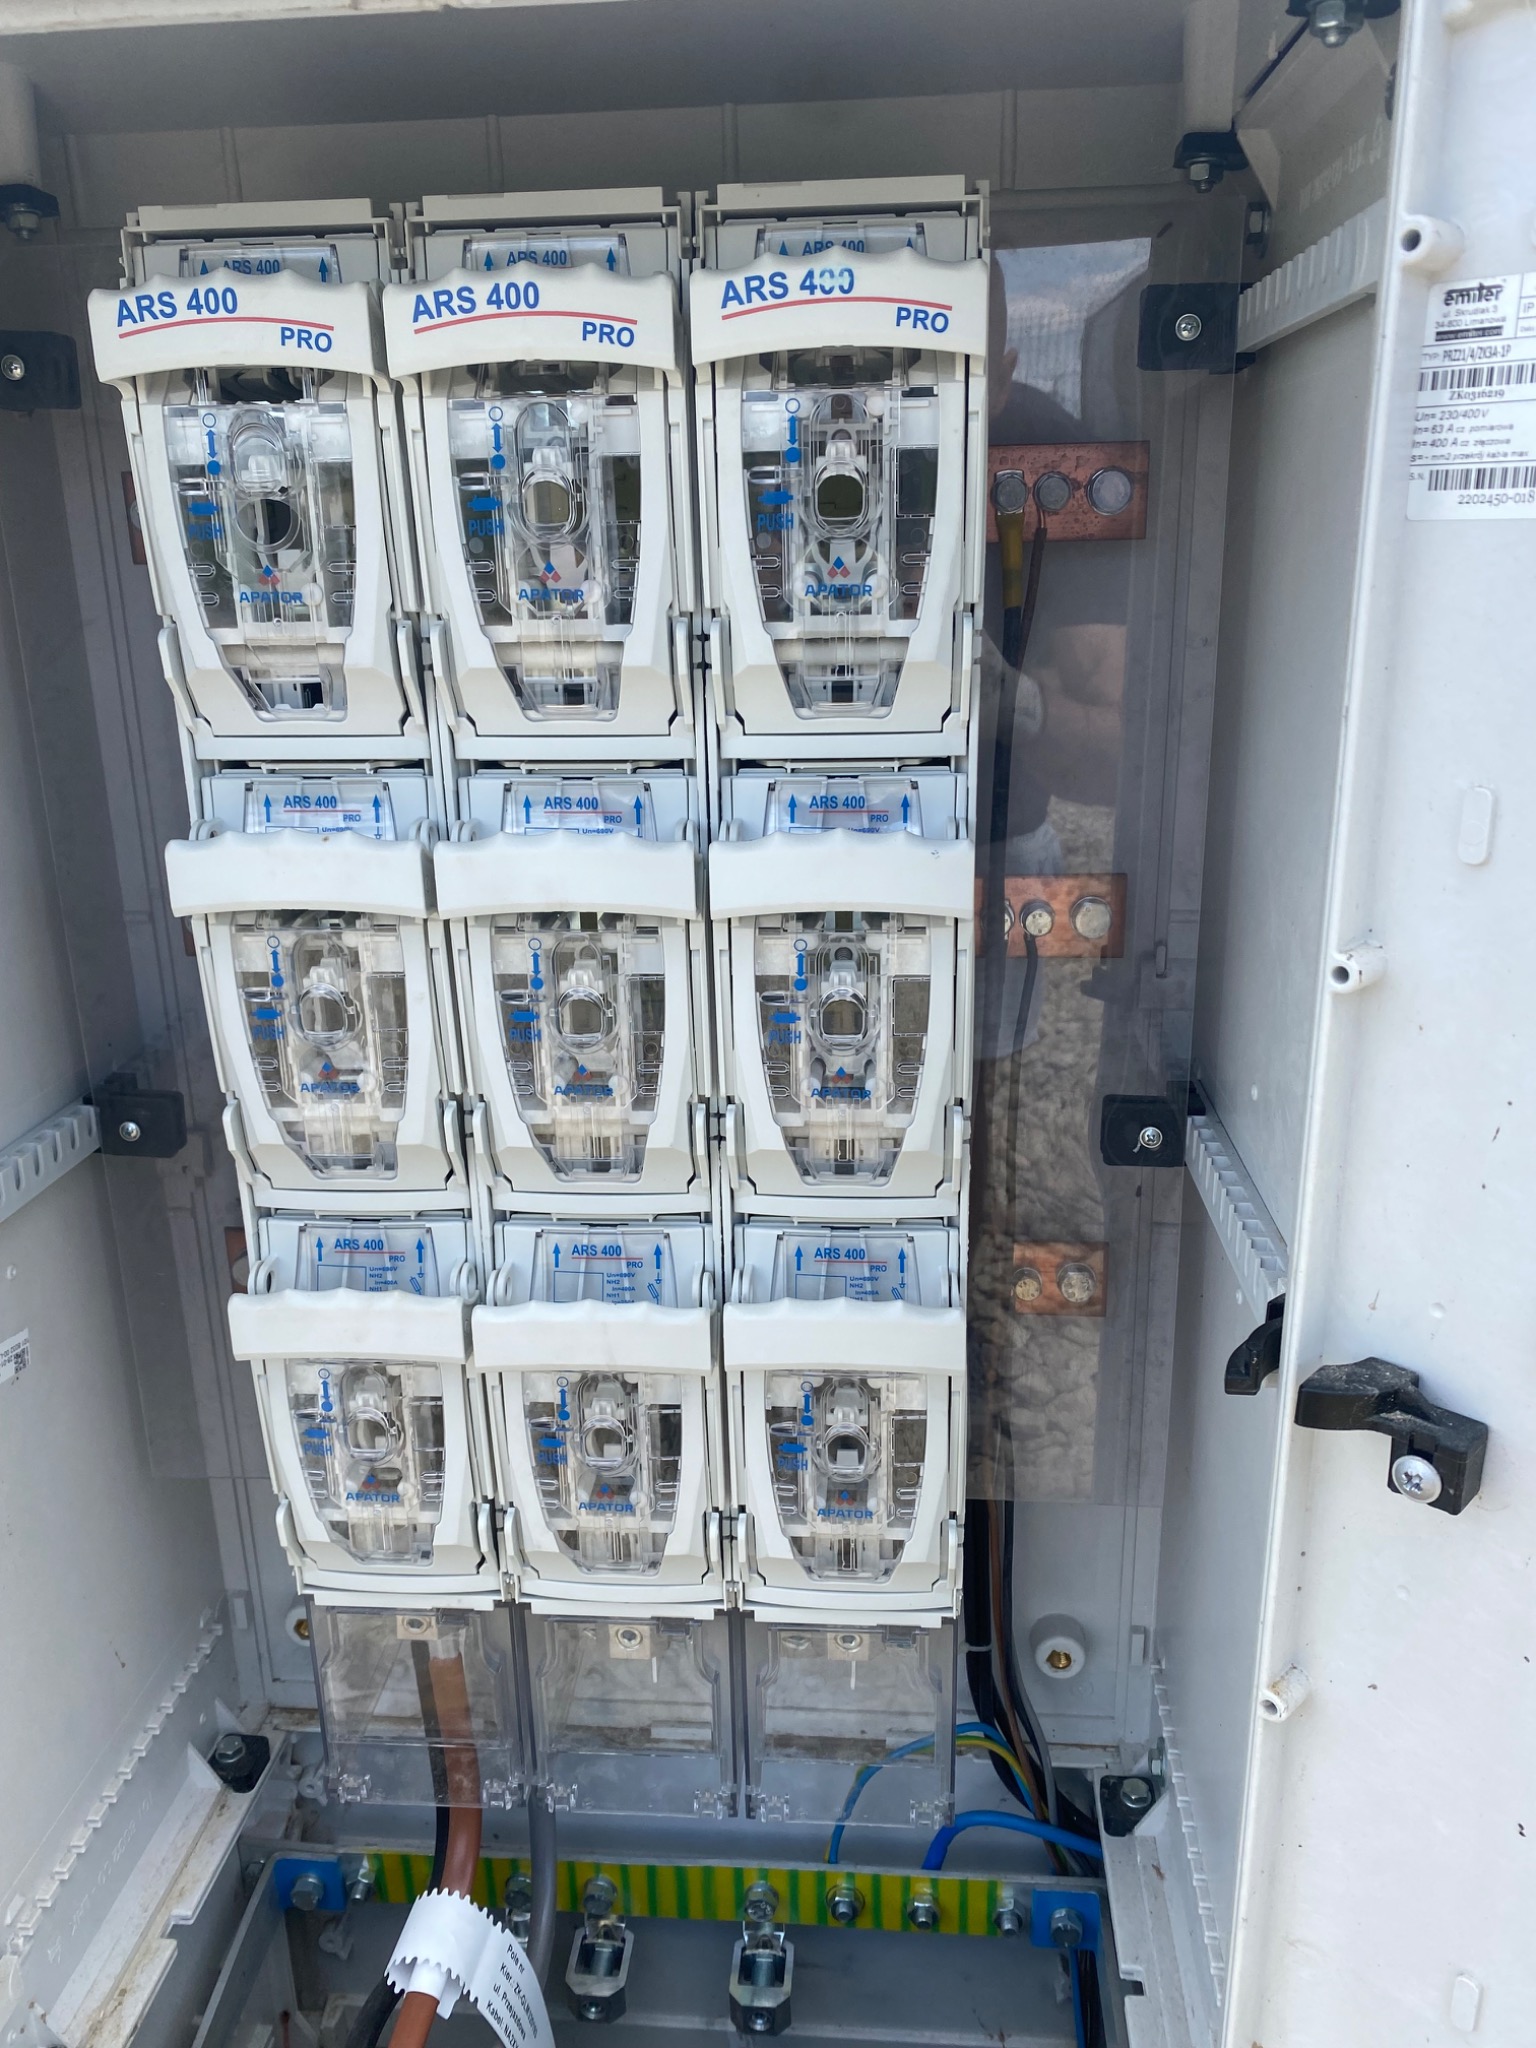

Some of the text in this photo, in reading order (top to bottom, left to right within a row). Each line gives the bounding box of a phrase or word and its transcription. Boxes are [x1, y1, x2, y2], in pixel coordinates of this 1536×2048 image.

[542, 250, 567, 266] 400
[256, 259, 280, 274] 400
[720, 271, 789, 309] ARS
[117, 286, 238, 328] ARS 400
[411, 281, 540, 323] ARS 400
[895, 307, 949, 334] PRO
[280, 327, 333, 353] PRO
[581, 321, 635, 348] PRO
[1448, 389, 1505, 401] ZK0316219
[1429, 438, 1448, 448] 400
[468, 518, 504, 536] PUSH
[758, 513, 795, 531] PUSH
[188, 524, 224, 540] PUSH
[239, 590, 304, 605] APATOR
[518, 586, 585, 602] APATOR
[804, 583, 873, 598] APATOR
[283, 795, 338, 809] ARS 400
[543, 796, 599, 810] ARS 400
[809, 795, 866, 810] ARS 400
[343, 813, 361, 822] PRO
[603, 815, 623, 824] PRO
[870, 814, 889, 823] PRO
[253, 1025, 286, 1040] PUSH
[509, 1027, 542, 1042] PUSH
[768, 1030, 802, 1044] PUSH
[300, 1081, 361, 1094] APATOR
[553, 1084, 614, 1097] APATOR
[810, 1087, 872, 1099] APATOR
[334, 1237, 384, 1251] ARS 400
[571, 1243, 622, 1257] ARS 400
[388, 1254, 406, 1263] PRO
[814, 1247, 866, 1260] ARS 400
[304, 1443, 333, 1456] PUSH
[538, 1451, 568, 1465] PUSH
[777, 1458, 809, 1471] PUSH
[346, 1491, 401, 1503] APATOR
[578, 1500, 634, 1512] APATOR
[816, 1508, 874, 1519] APATOR
